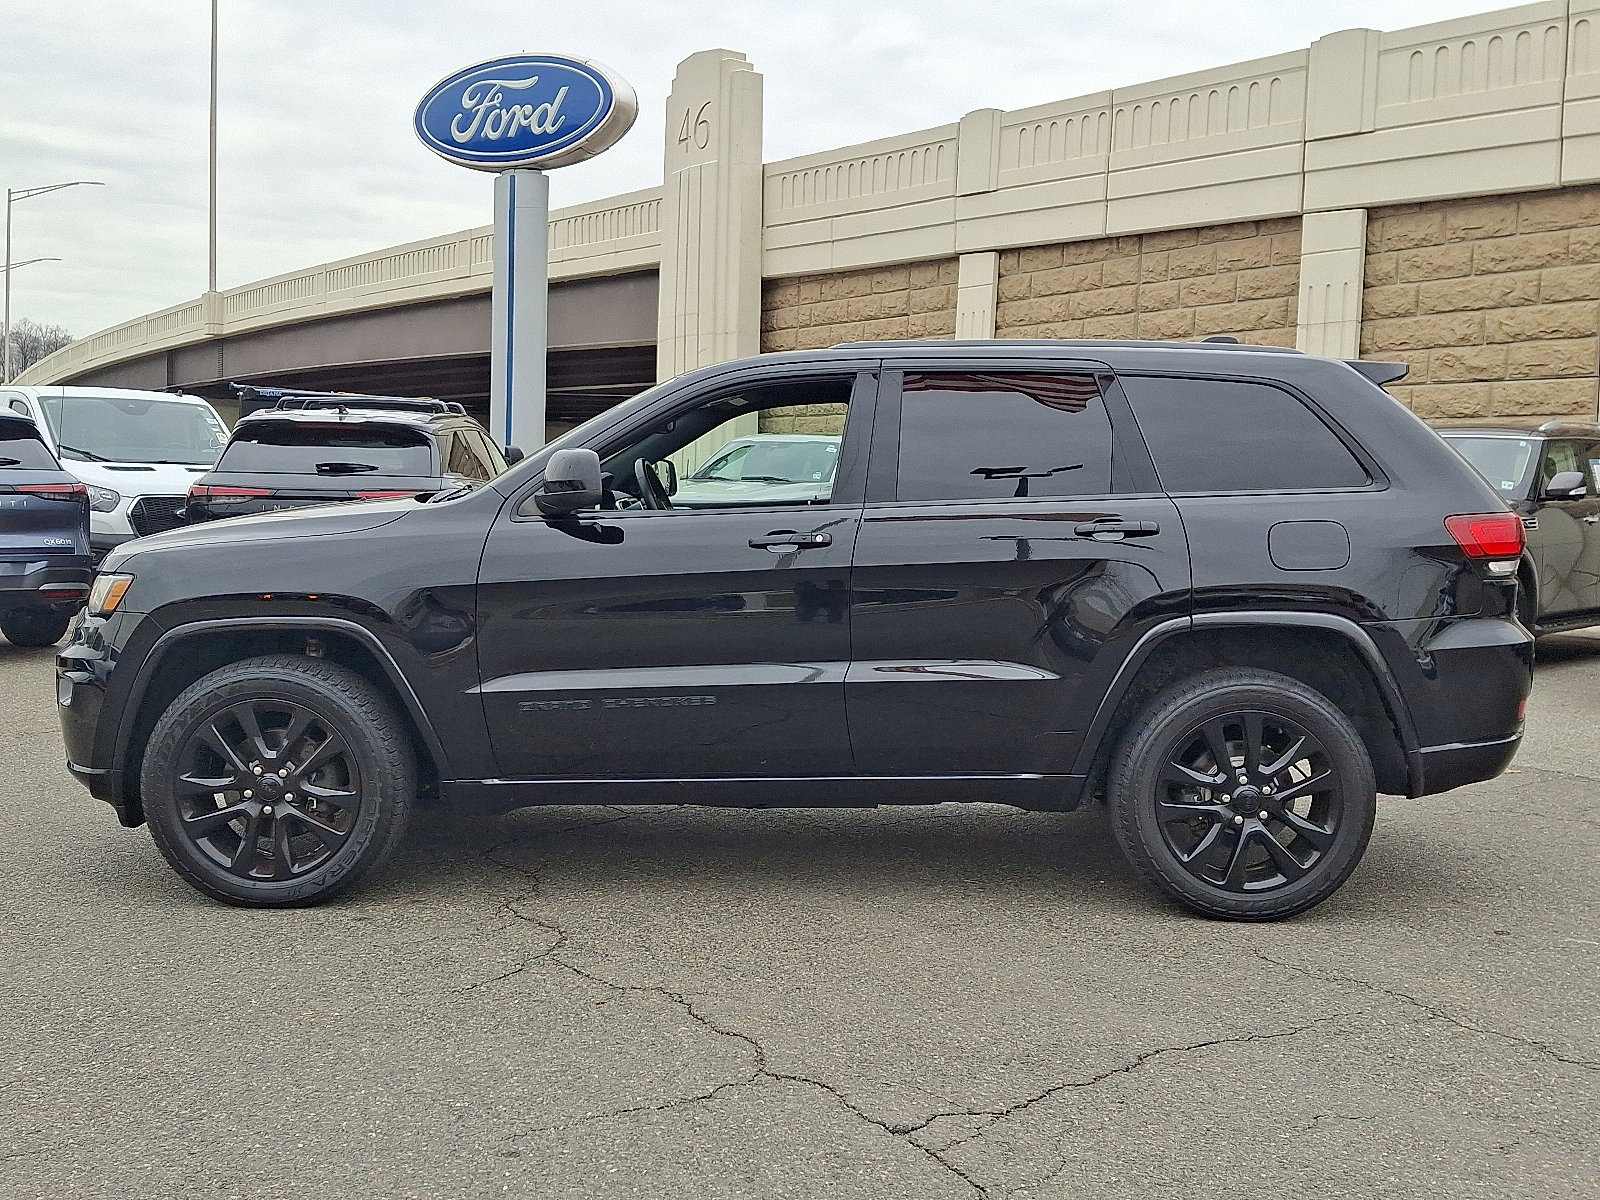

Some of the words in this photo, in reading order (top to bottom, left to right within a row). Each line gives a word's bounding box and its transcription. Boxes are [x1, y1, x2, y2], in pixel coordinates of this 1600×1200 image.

[451, 75, 569, 143] Ford
[678, 100, 711, 154] 46
[601, 695, 717, 709] CHEROKEE
